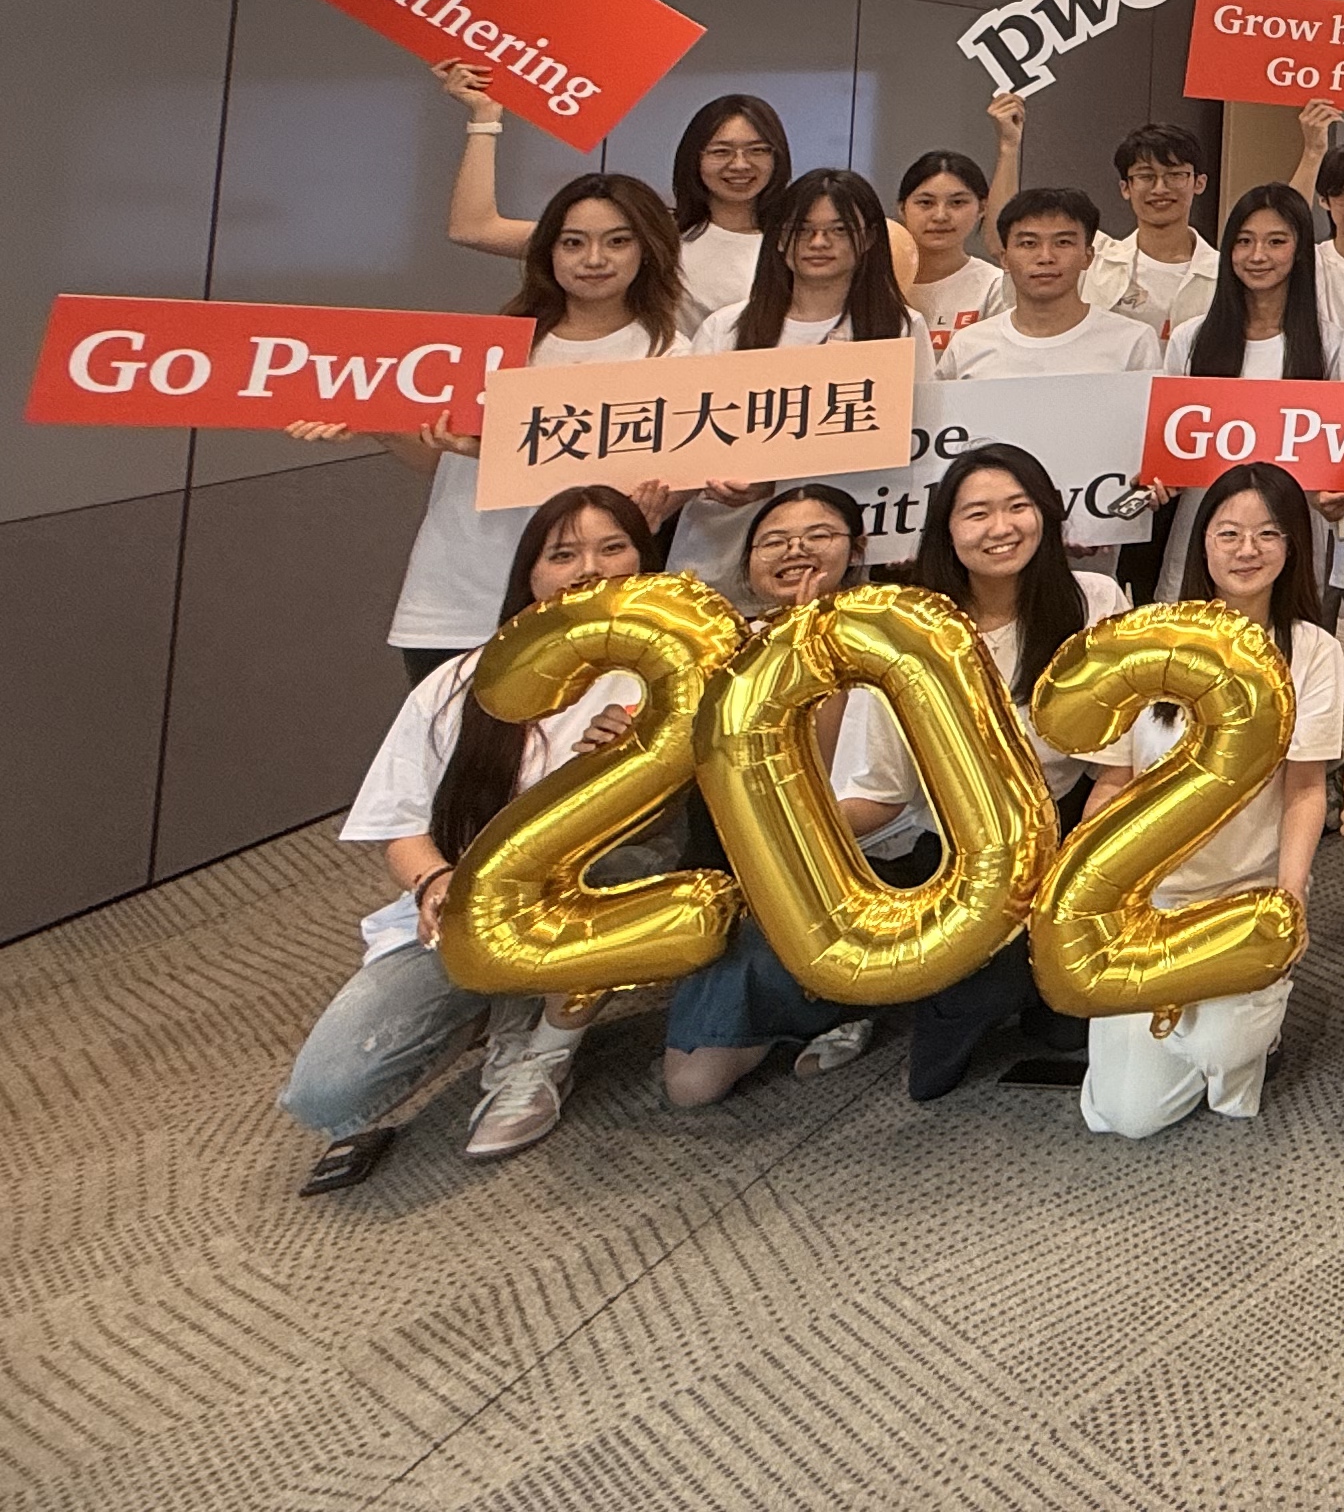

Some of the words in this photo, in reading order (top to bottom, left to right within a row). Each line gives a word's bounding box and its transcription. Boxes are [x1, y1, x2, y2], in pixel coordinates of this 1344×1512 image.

[1212, 4, 1323, 41] Grow
[1265, 56, 1321, 91] Go
[67, 329, 212, 396] Go
[518, 377, 881, 468] 校园大明星
[1163, 404, 1255, 462] Go
